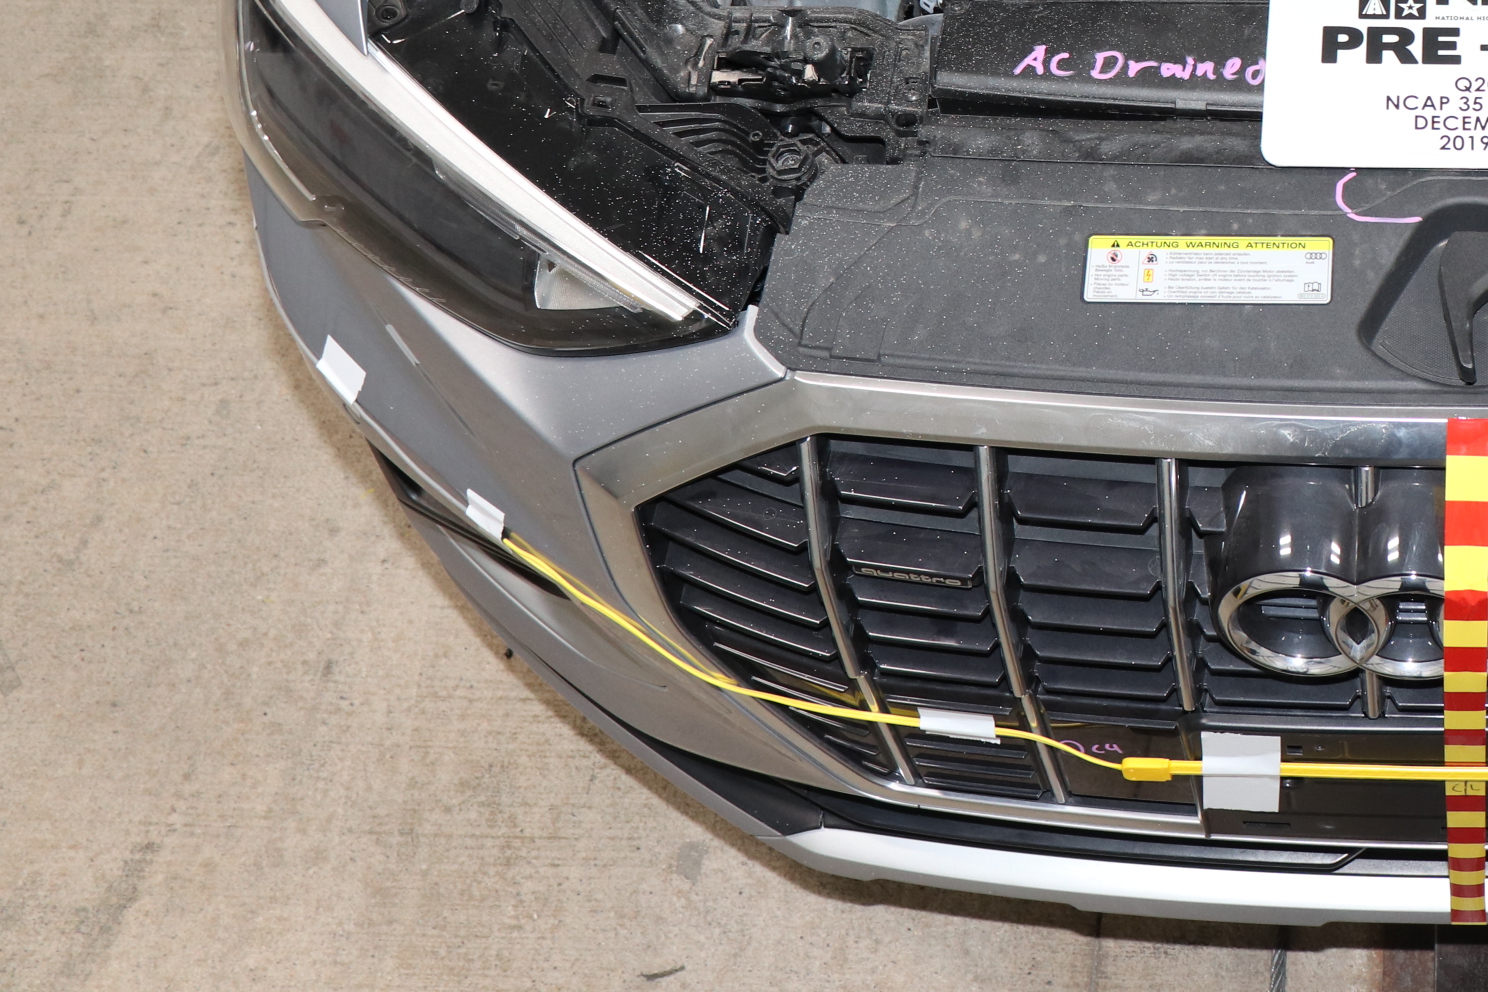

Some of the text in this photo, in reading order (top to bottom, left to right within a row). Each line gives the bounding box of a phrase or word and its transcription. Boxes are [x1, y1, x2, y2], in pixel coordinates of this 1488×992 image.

[1321, 26, 1462, 65] PRE
[1013, 44, 1075, 77] AC
[1386, 95, 1450, 111] NCAP
[1458, 96, 1483, 111] 35
[1126, 240, 1179, 249] ACHTUNG
[1185, 241, 1240, 249] WARNING
[861, 567, 961, 586] quattro
